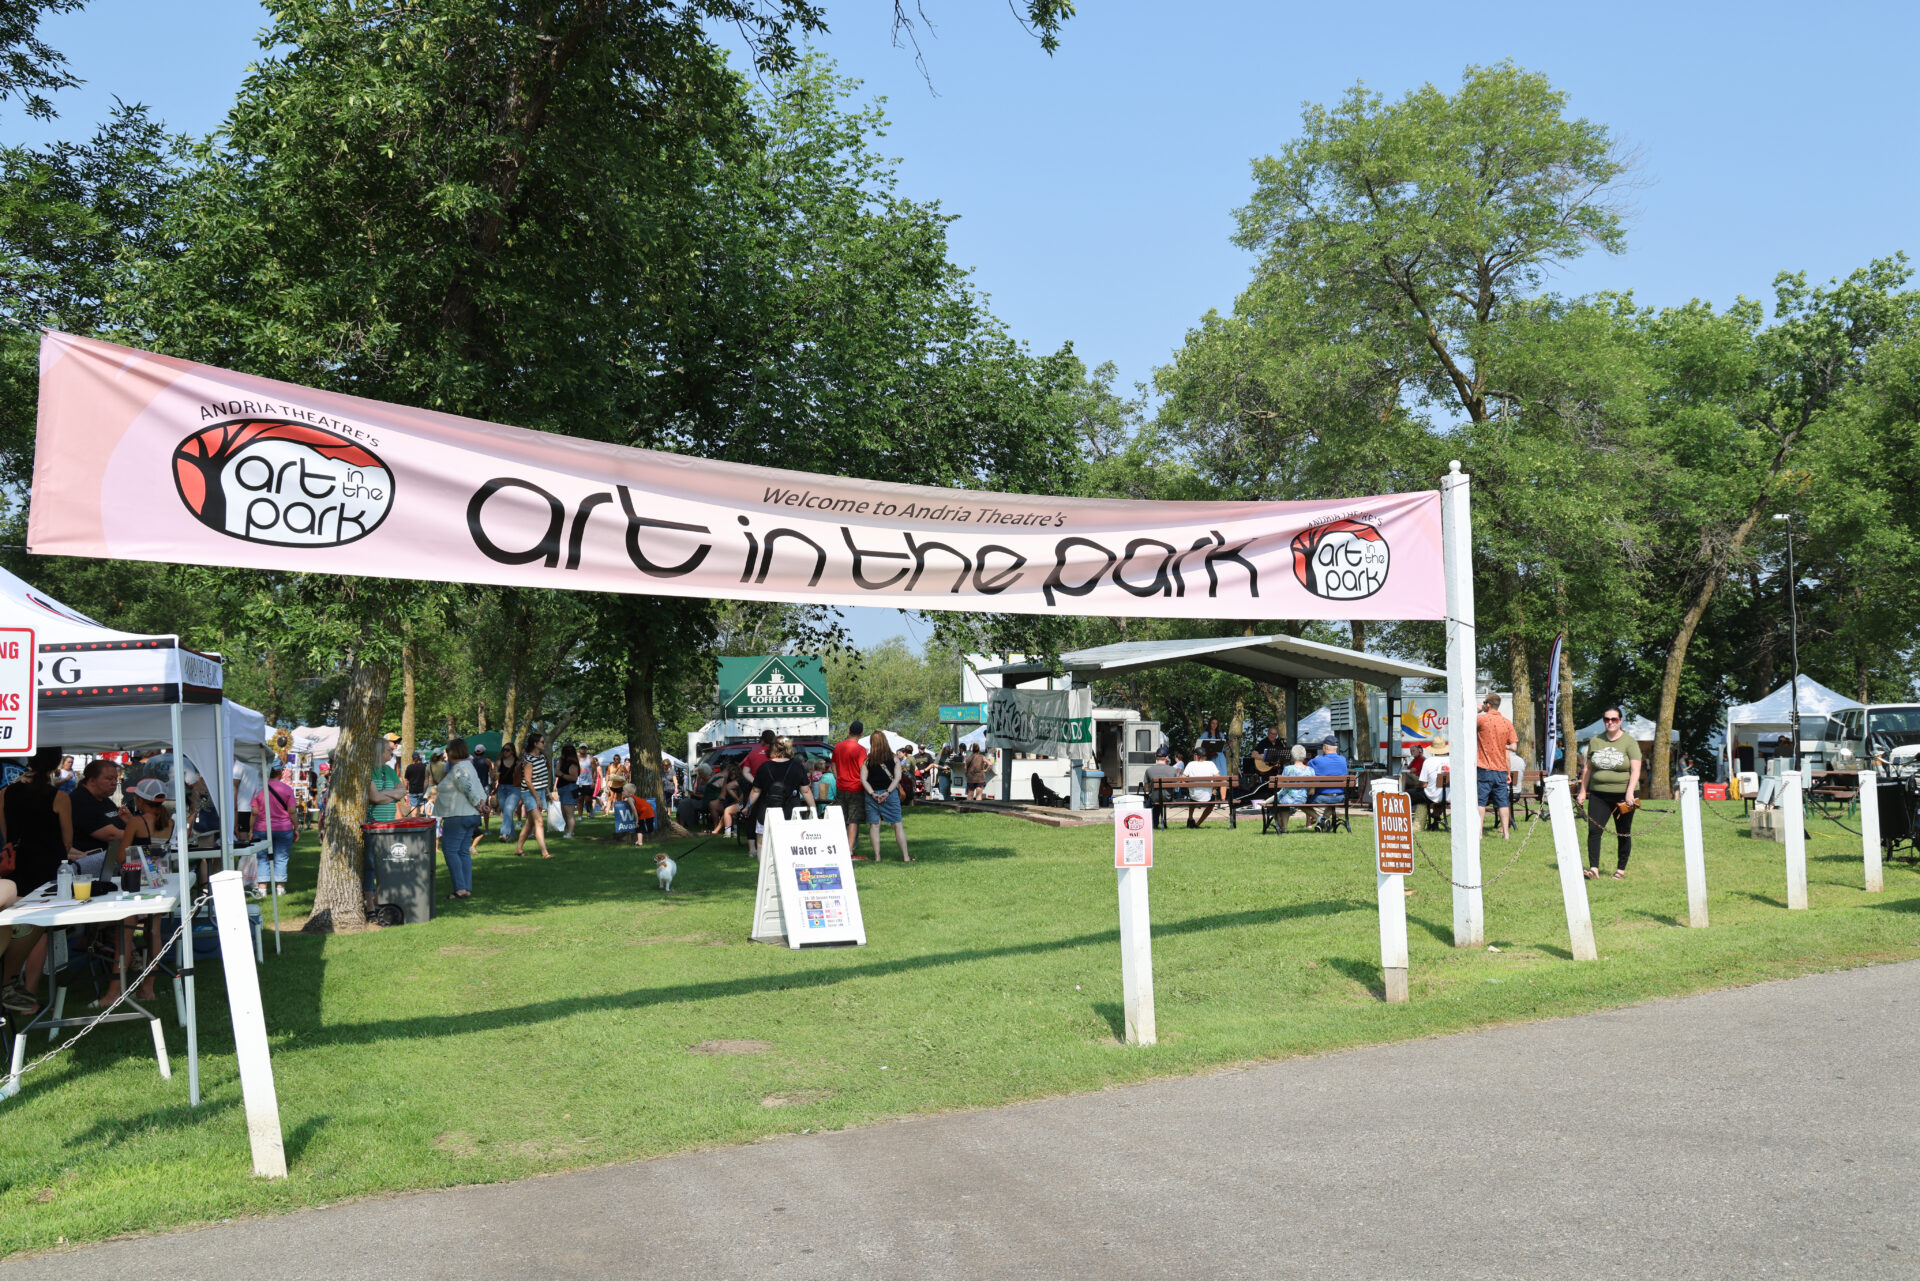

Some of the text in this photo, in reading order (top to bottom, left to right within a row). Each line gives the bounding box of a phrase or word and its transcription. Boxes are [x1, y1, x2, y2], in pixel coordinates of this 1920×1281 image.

[200, 400, 381, 447] ANDRIA THEATRE'S
[235, 455, 336, 499] art
[347, 467, 364, 484] in
[343, 482, 383, 501] the
[762, 487, 1068, 527] Welcome to Andria Theatre's
[245, 497, 366, 542] park
[466, 477, 1259, 606] art in the park
[1366, 544, 1375, 554] in
[1318, 540, 1362, 567] art
[1365, 554, 1385, 564] the
[1326, 568, 1381, 597] park
[756, 685, 796, 696] BEAU
[750, 696, 803, 704] COFFEE CO.
[1382, 797, 1405, 813] PARK
[1381, 816, 1408, 832] HOURS
[790, 845, 817, 856] Water
[827, 845, 837, 855] $1
